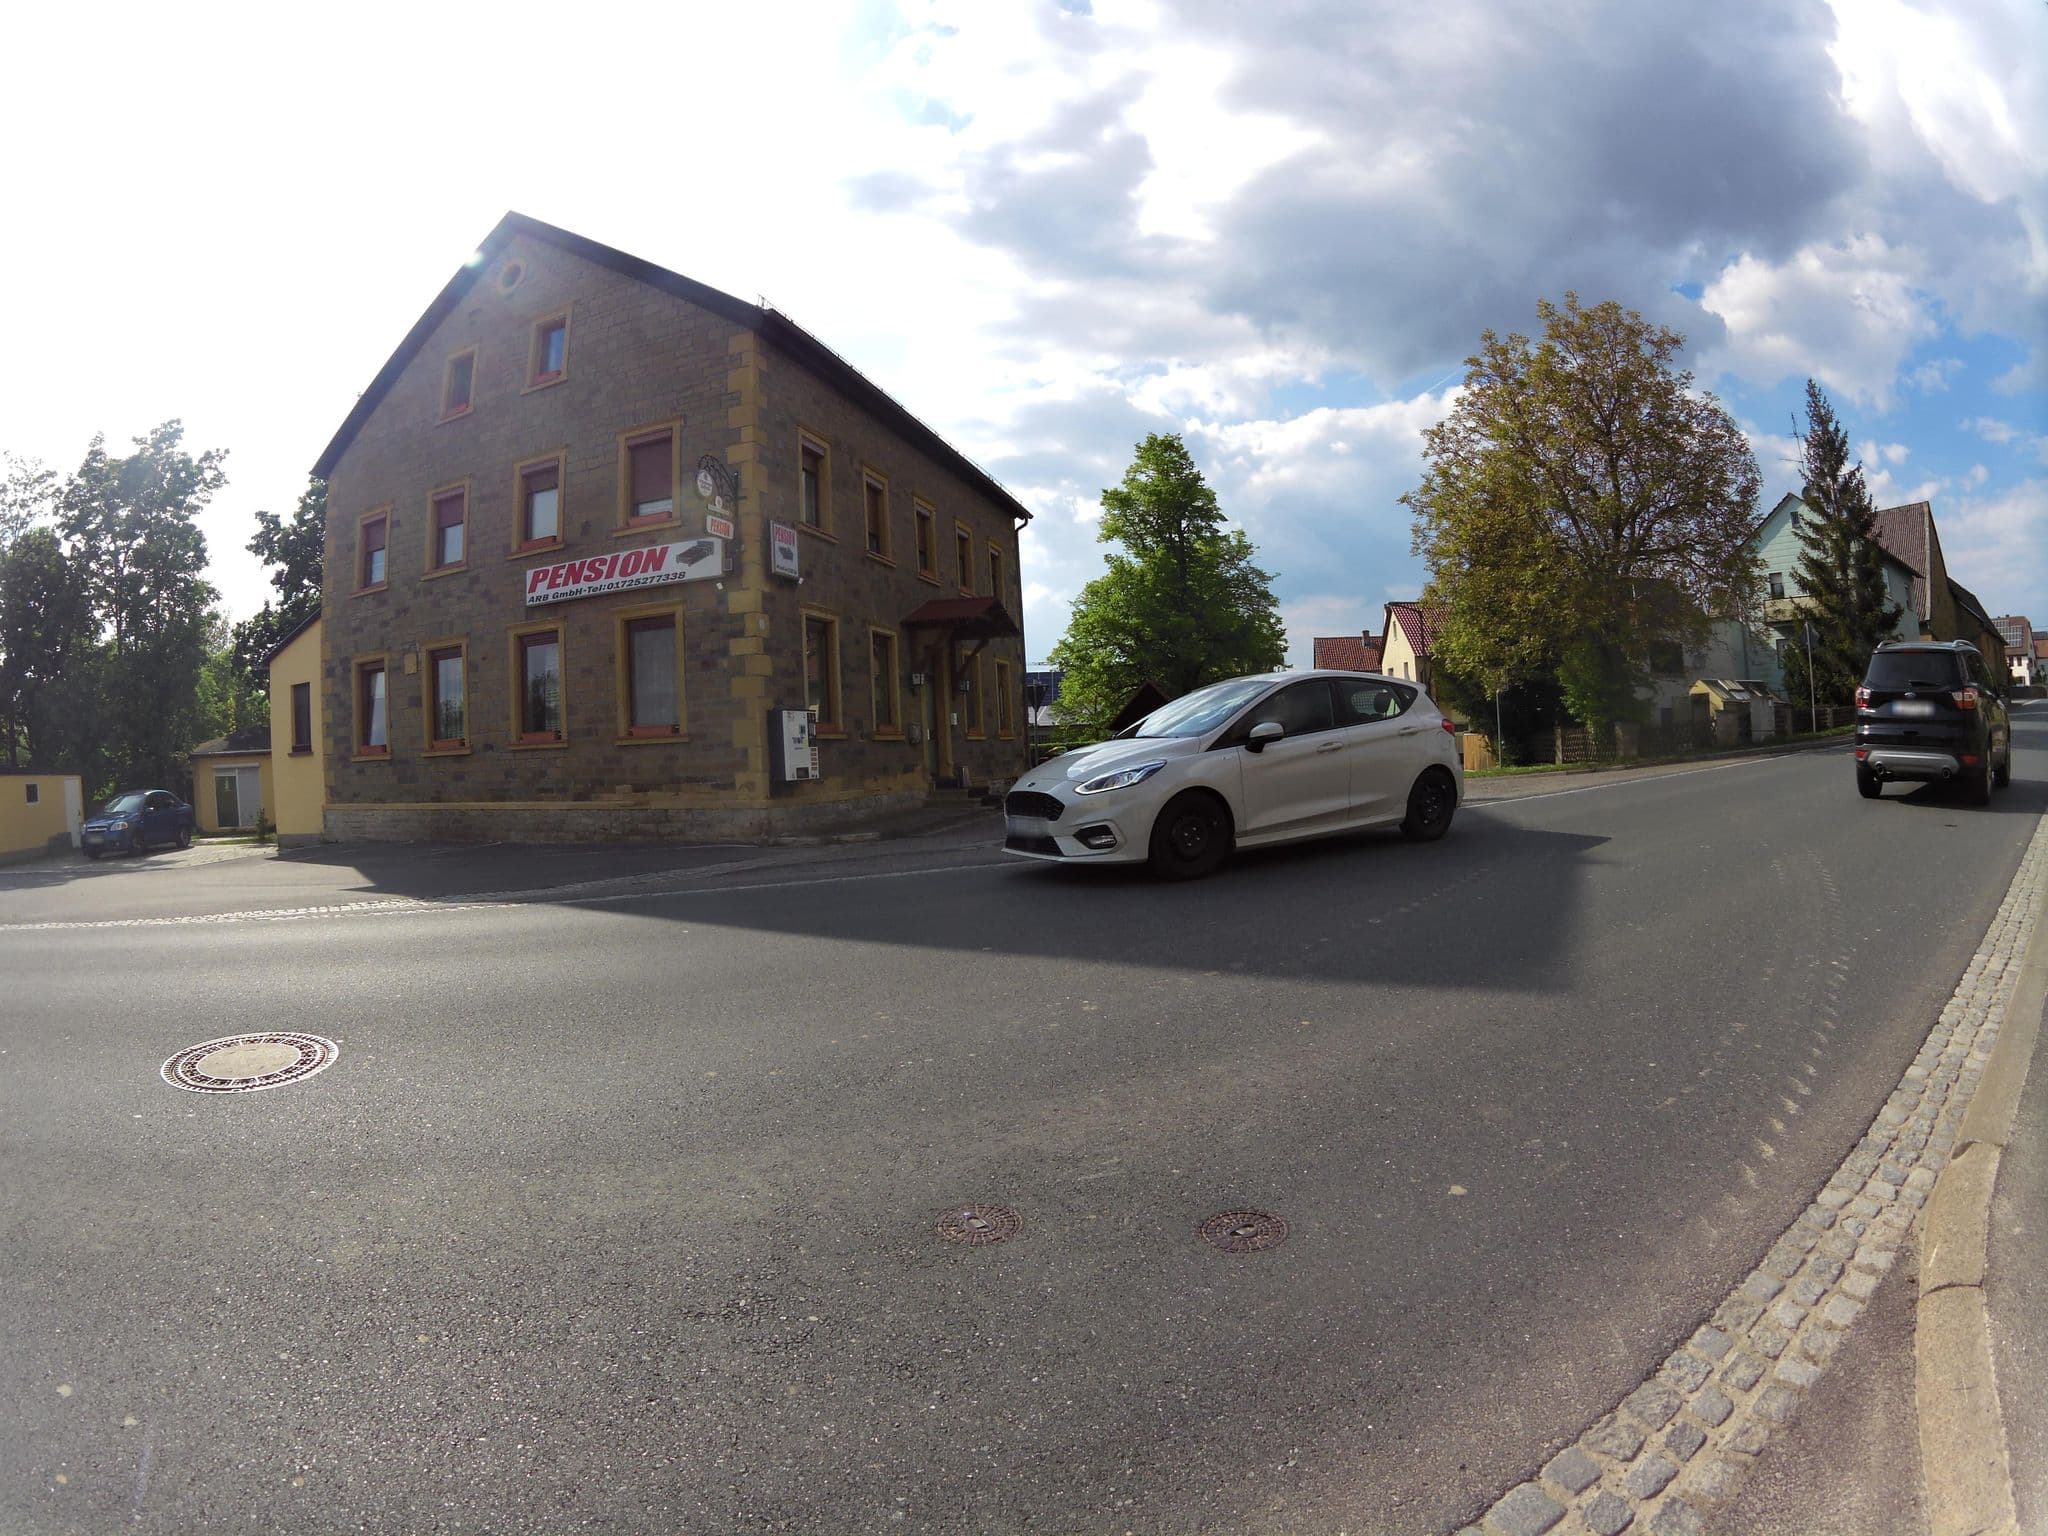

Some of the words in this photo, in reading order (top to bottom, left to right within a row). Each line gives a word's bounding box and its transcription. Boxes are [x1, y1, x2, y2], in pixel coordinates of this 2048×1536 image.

[711, 518, 731, 537] PENSION
[774, 524, 796, 546] PENSION
[528, 546, 669, 594] PENSION
[528, 594, 549, 604] ARB
